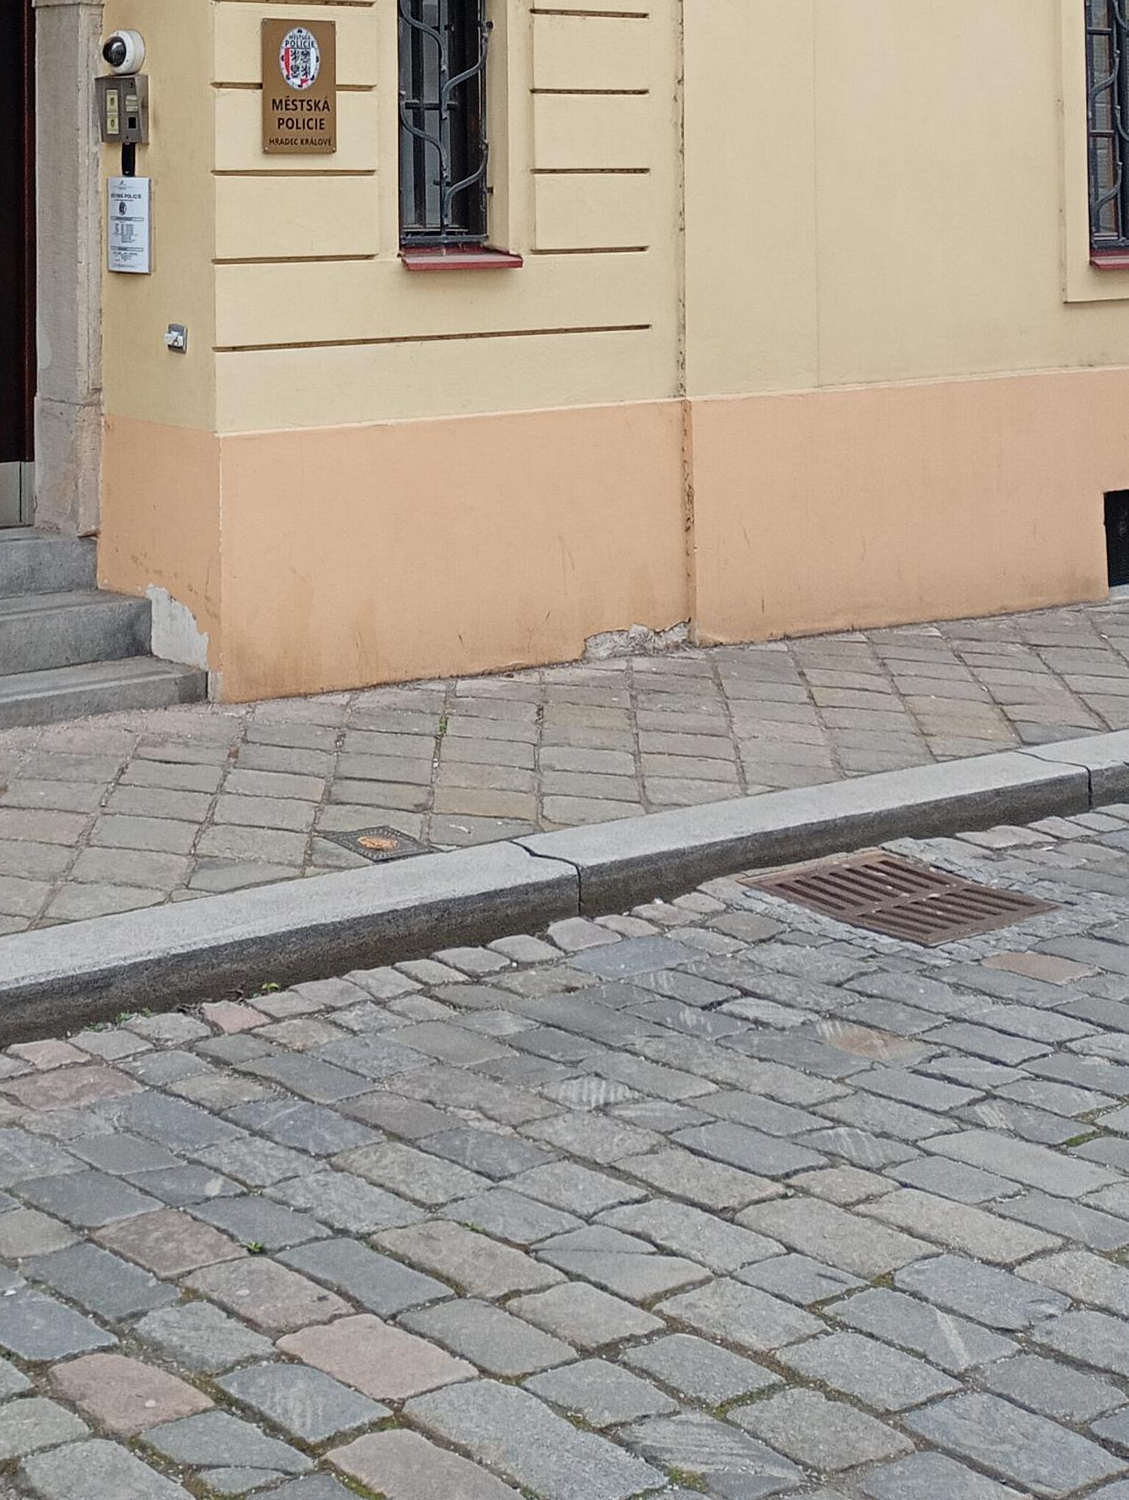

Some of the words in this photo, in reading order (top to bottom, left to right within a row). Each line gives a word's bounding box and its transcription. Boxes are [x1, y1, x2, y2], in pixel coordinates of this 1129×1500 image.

[284, 39, 314, 48] POLICIE
[271, 95, 330, 112] MĚSTSKÁ
[277, 117, 325, 131] POLICIE
[269, 137, 299, 146] HRADEC
[300, 136, 332, 146] KRÁLOVÉ
